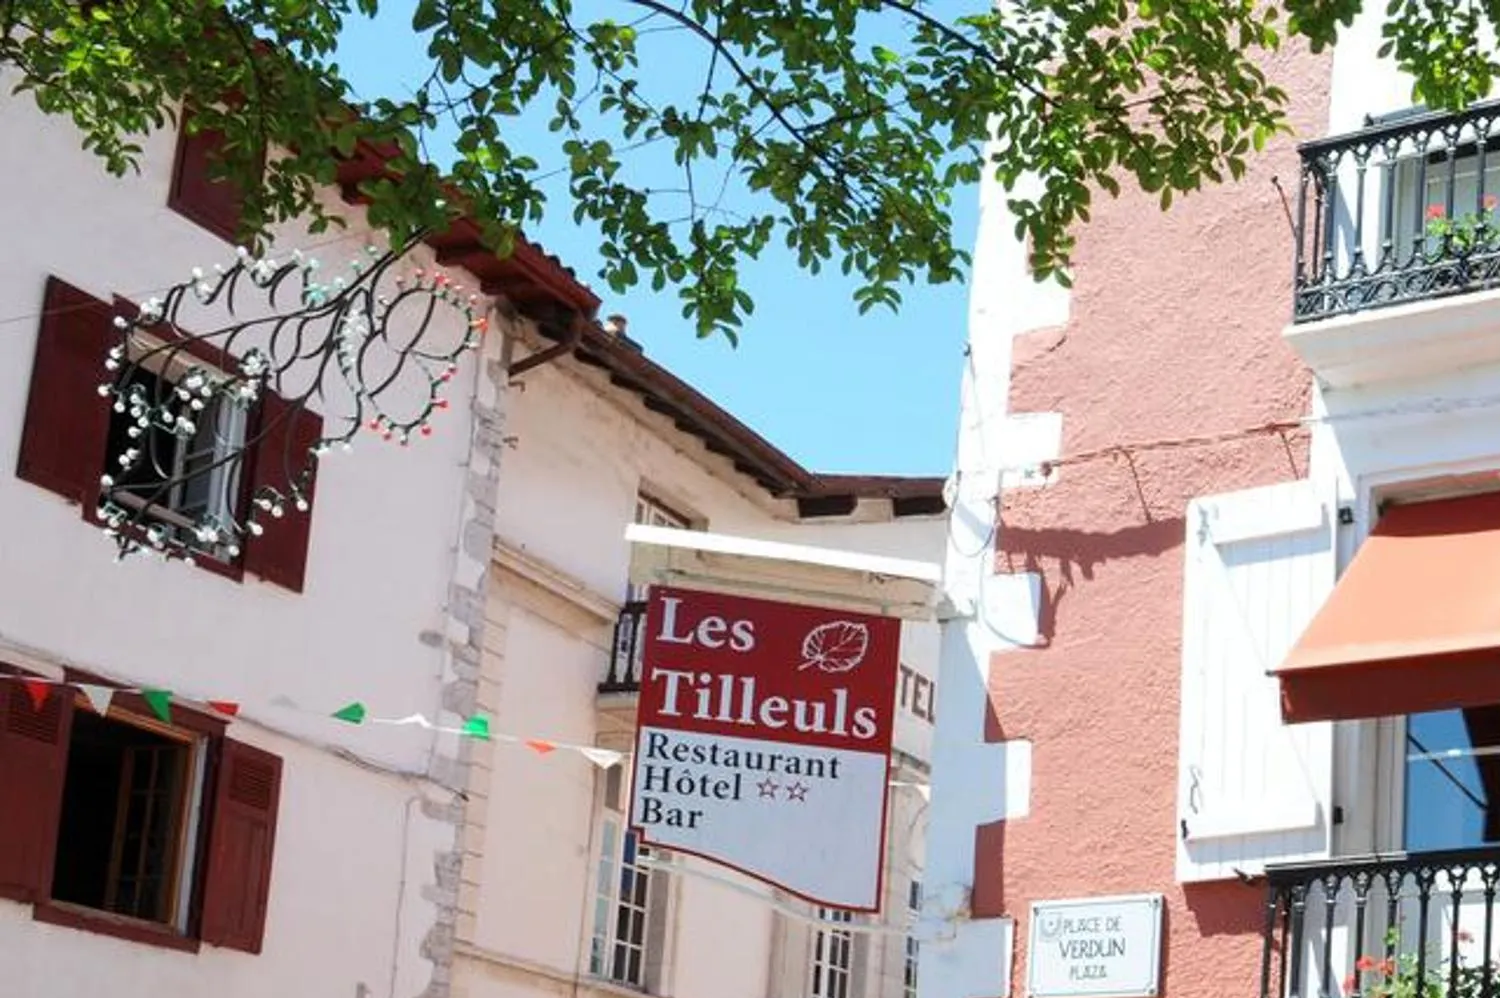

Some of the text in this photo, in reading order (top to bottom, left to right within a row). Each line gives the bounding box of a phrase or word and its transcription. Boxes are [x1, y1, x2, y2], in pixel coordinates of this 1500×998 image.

[656, 597, 755, 651] Les
[651, 666, 877, 739] Tilleuls
[646, 732, 841, 779] Restaurant
[643, 763, 741, 801] Hôtel
[640, 796, 703, 829] Bar
[1063, 915, 1122, 934] PLACE DE
[1058, 938, 1126, 960] VERDUN
[1069, 964, 1108, 980] PLAZA
